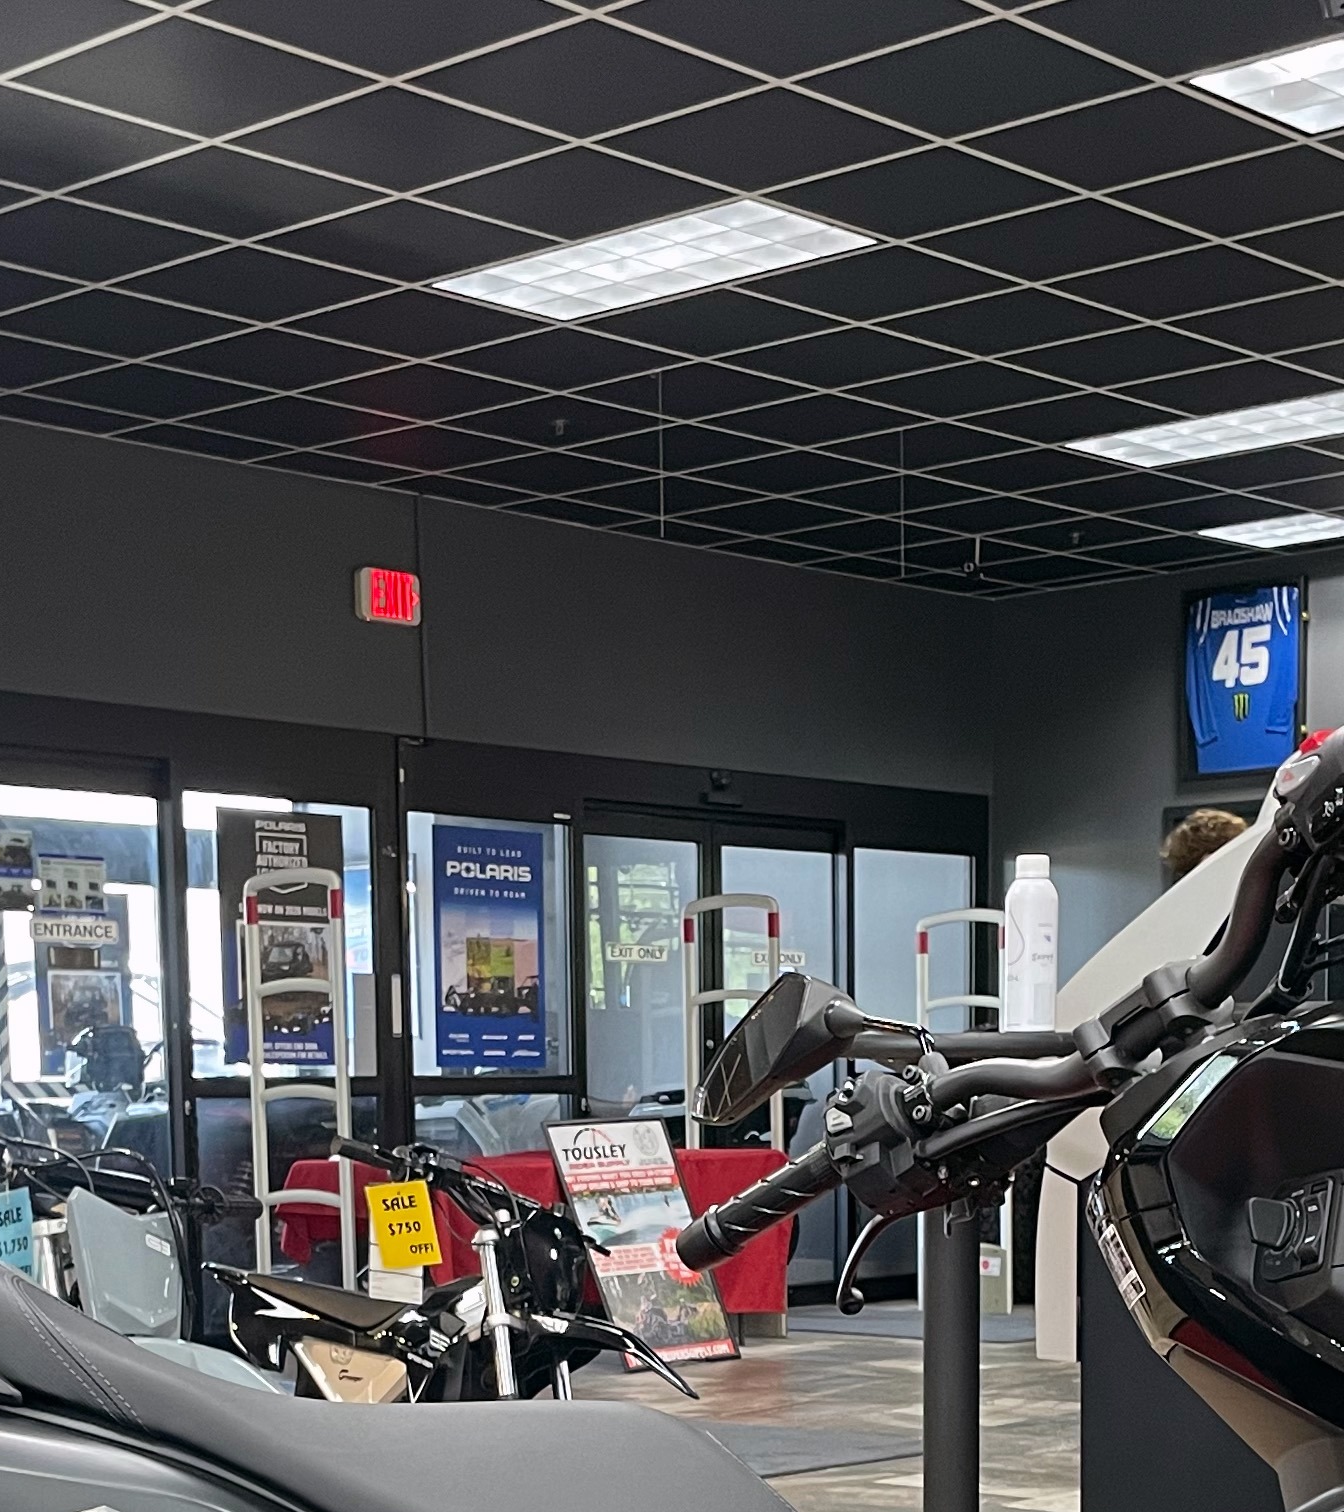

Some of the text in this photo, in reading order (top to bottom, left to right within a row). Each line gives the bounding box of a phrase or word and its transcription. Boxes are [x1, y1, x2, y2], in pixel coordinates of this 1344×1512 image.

[371, 570, 414, 621] EXIT
[1210, 601, 1274, 630] BRADSHAW
[1212, 624, 1271, 689] 45
[262, 840, 301, 855] FACTORY
[446, 860, 532, 882] POLARIS
[33, 922, 114, 940] ENTRANCE
[610, 947, 666, 960] EXIT ONLY
[780, 953, 804, 964] ONLY
[562, 1144, 626, 1161] TOUSLEY
[382, 1195, 417, 1212] SALE
[388, 1221, 421, 1237] $750
